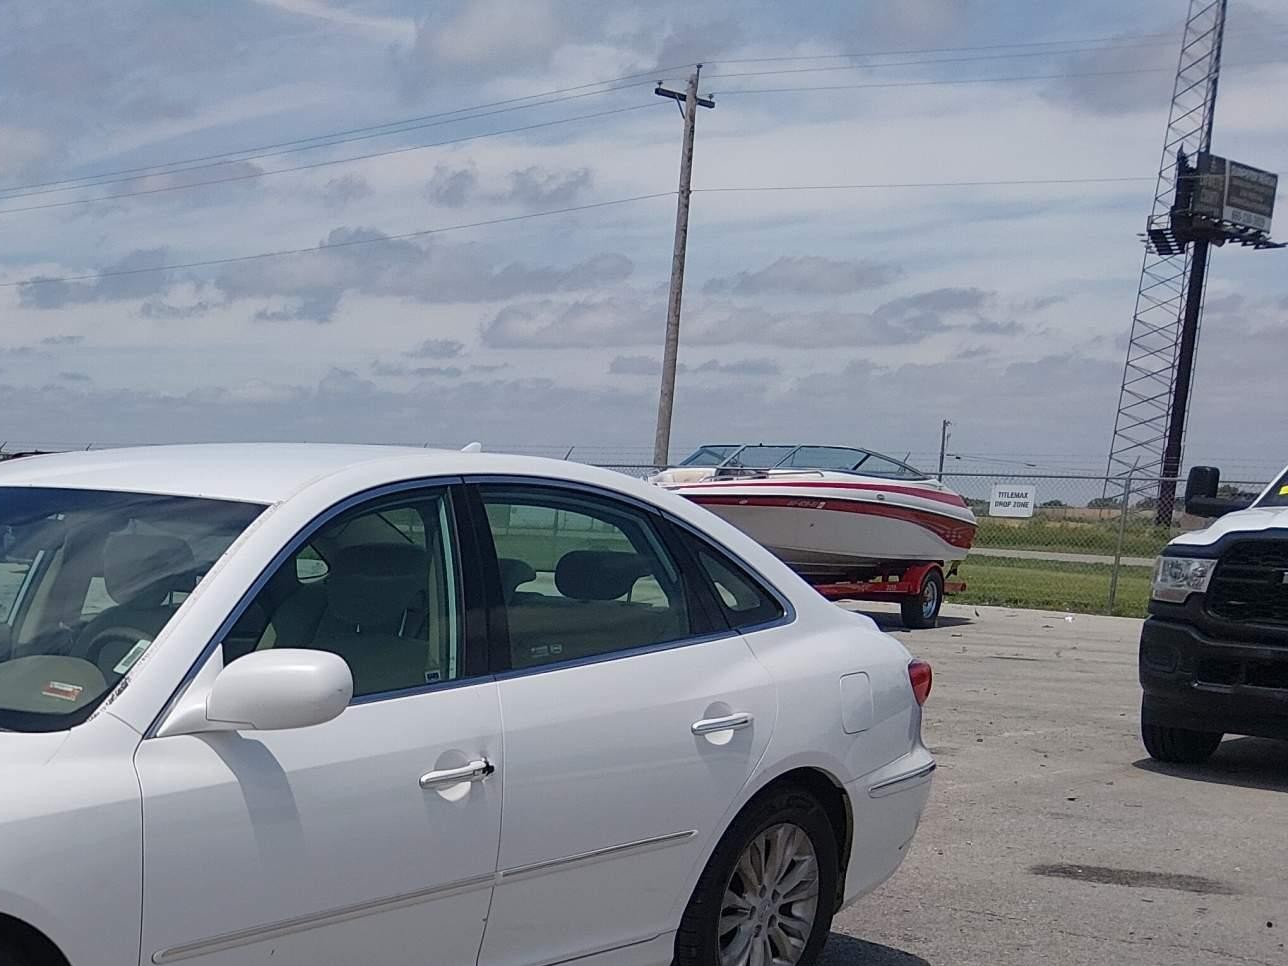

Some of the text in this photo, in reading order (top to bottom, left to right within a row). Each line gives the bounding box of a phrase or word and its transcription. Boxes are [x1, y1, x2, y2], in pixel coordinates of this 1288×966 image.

[998, 491, 1029, 499] TITLEMAX
[994, 500, 1030, 509] DROP ZONE
